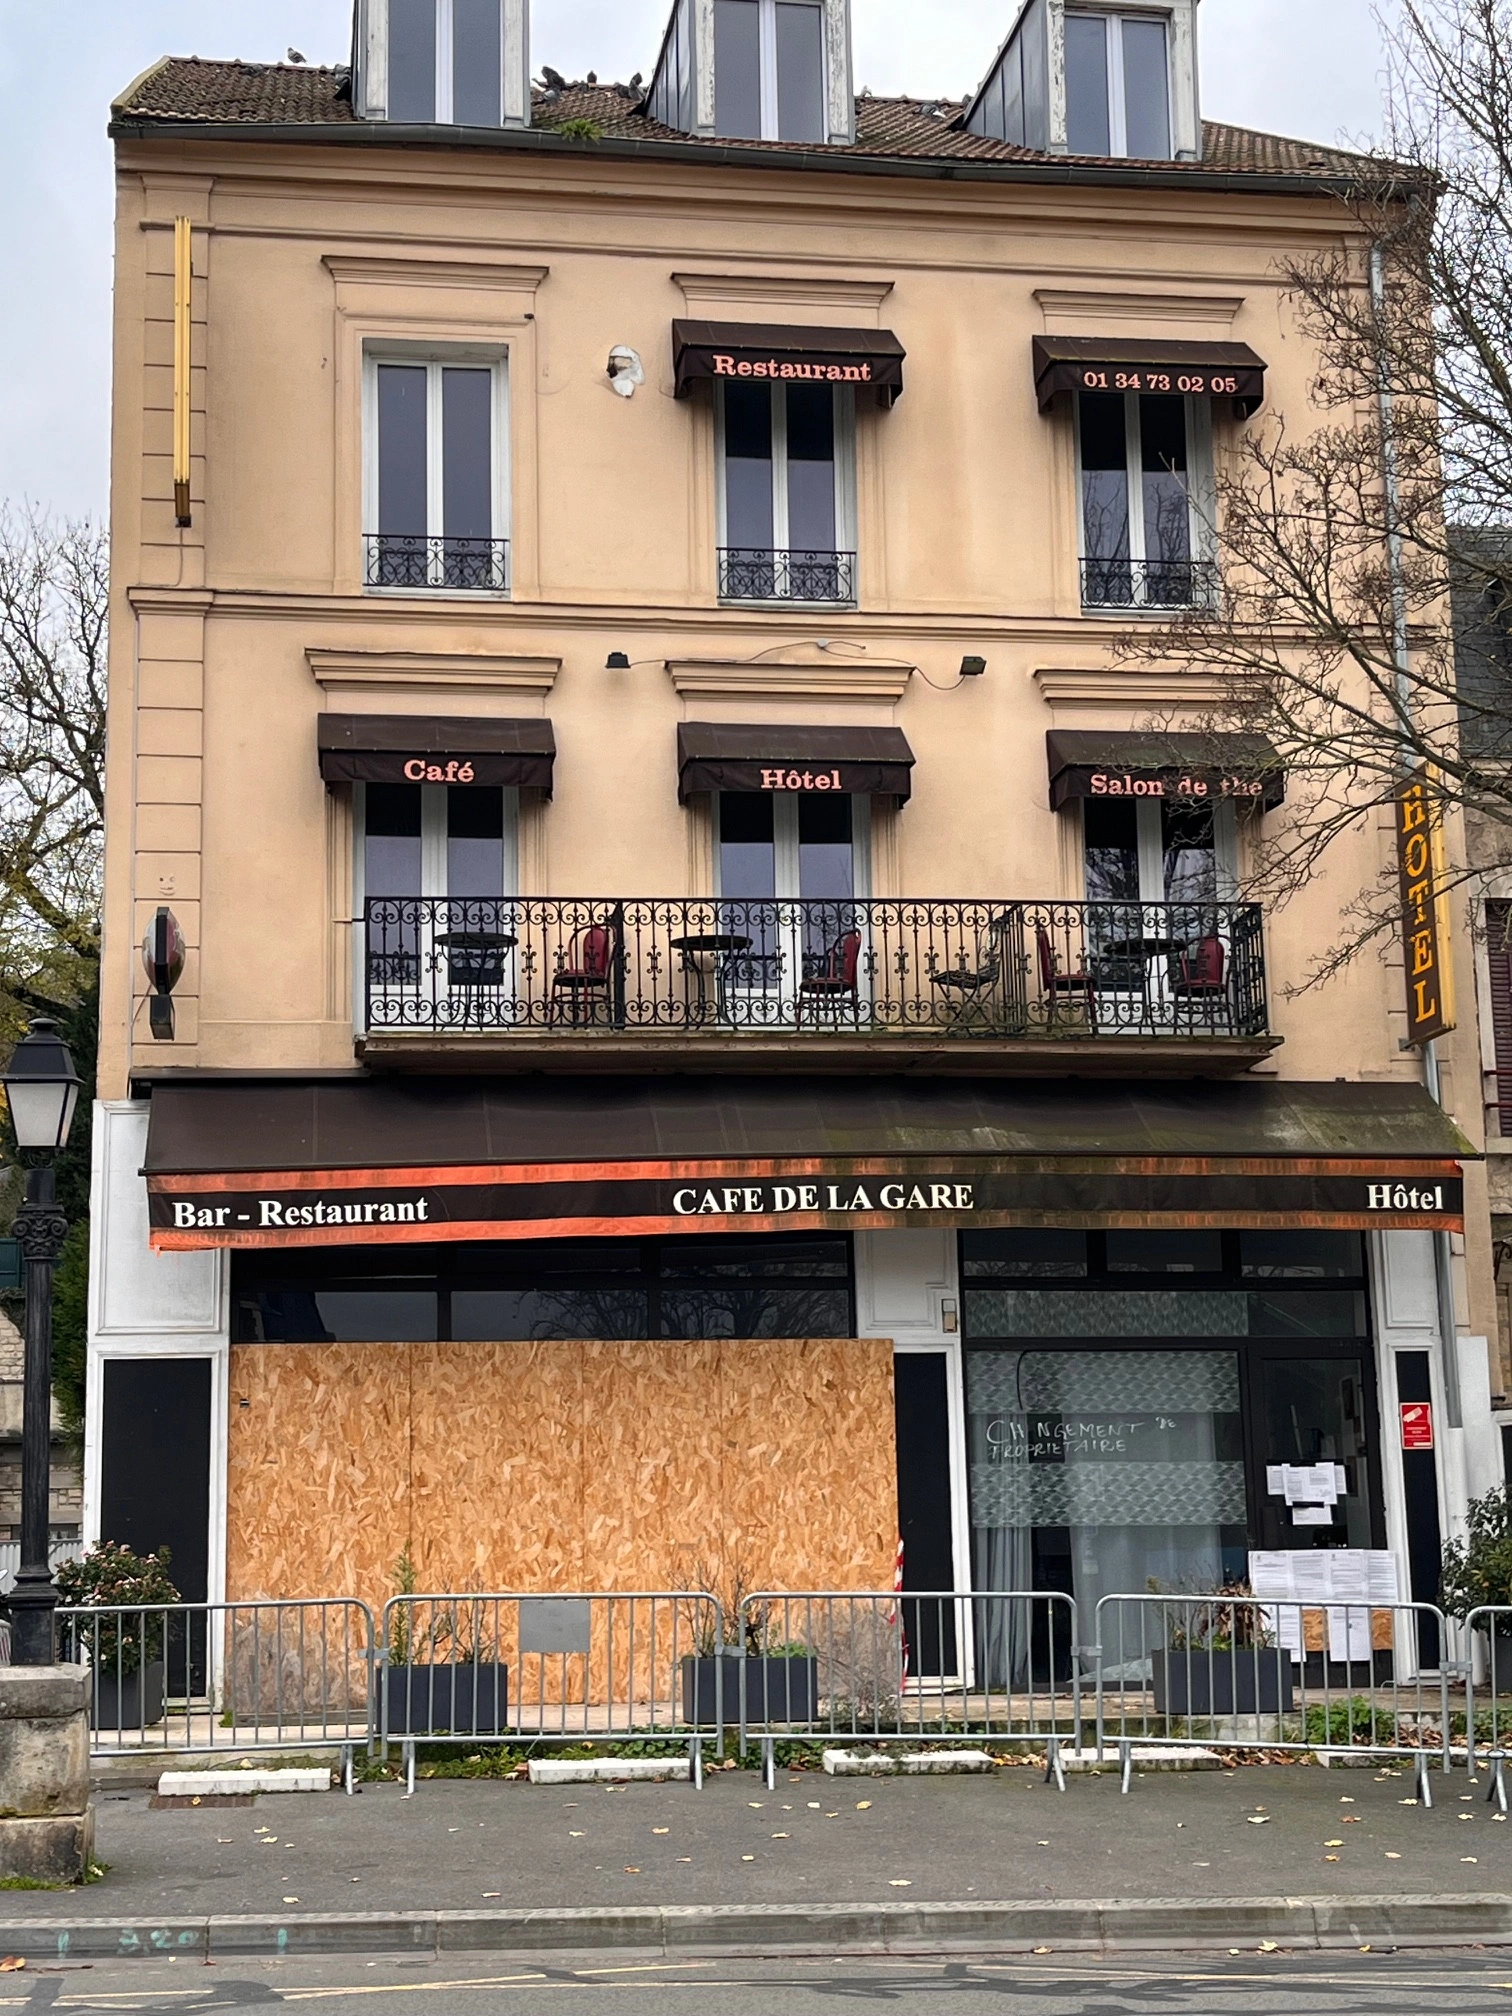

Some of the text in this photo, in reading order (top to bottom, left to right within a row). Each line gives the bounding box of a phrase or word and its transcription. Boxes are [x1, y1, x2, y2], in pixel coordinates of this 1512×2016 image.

[712, 354, 872, 382] Restaurant
[1083, 371, 1238, 393] 01 34 73 02 05
[403, 759, 475, 783] Café
[760, 769, 842, 790] Hôtel
[1090, 774, 1165, 796] Salon
[1177, 776, 1208, 796] de
[1401, 784, 1436, 1024] HOTEL
[672, 1184, 975, 1214] CAFE DE LA GARE
[1366, 1183, 1444, 1210] Hôtel
[172, 1196, 429, 1228] Bar - Restaurant
[986, 1419, 1145, 1444] CHNGEMENT
